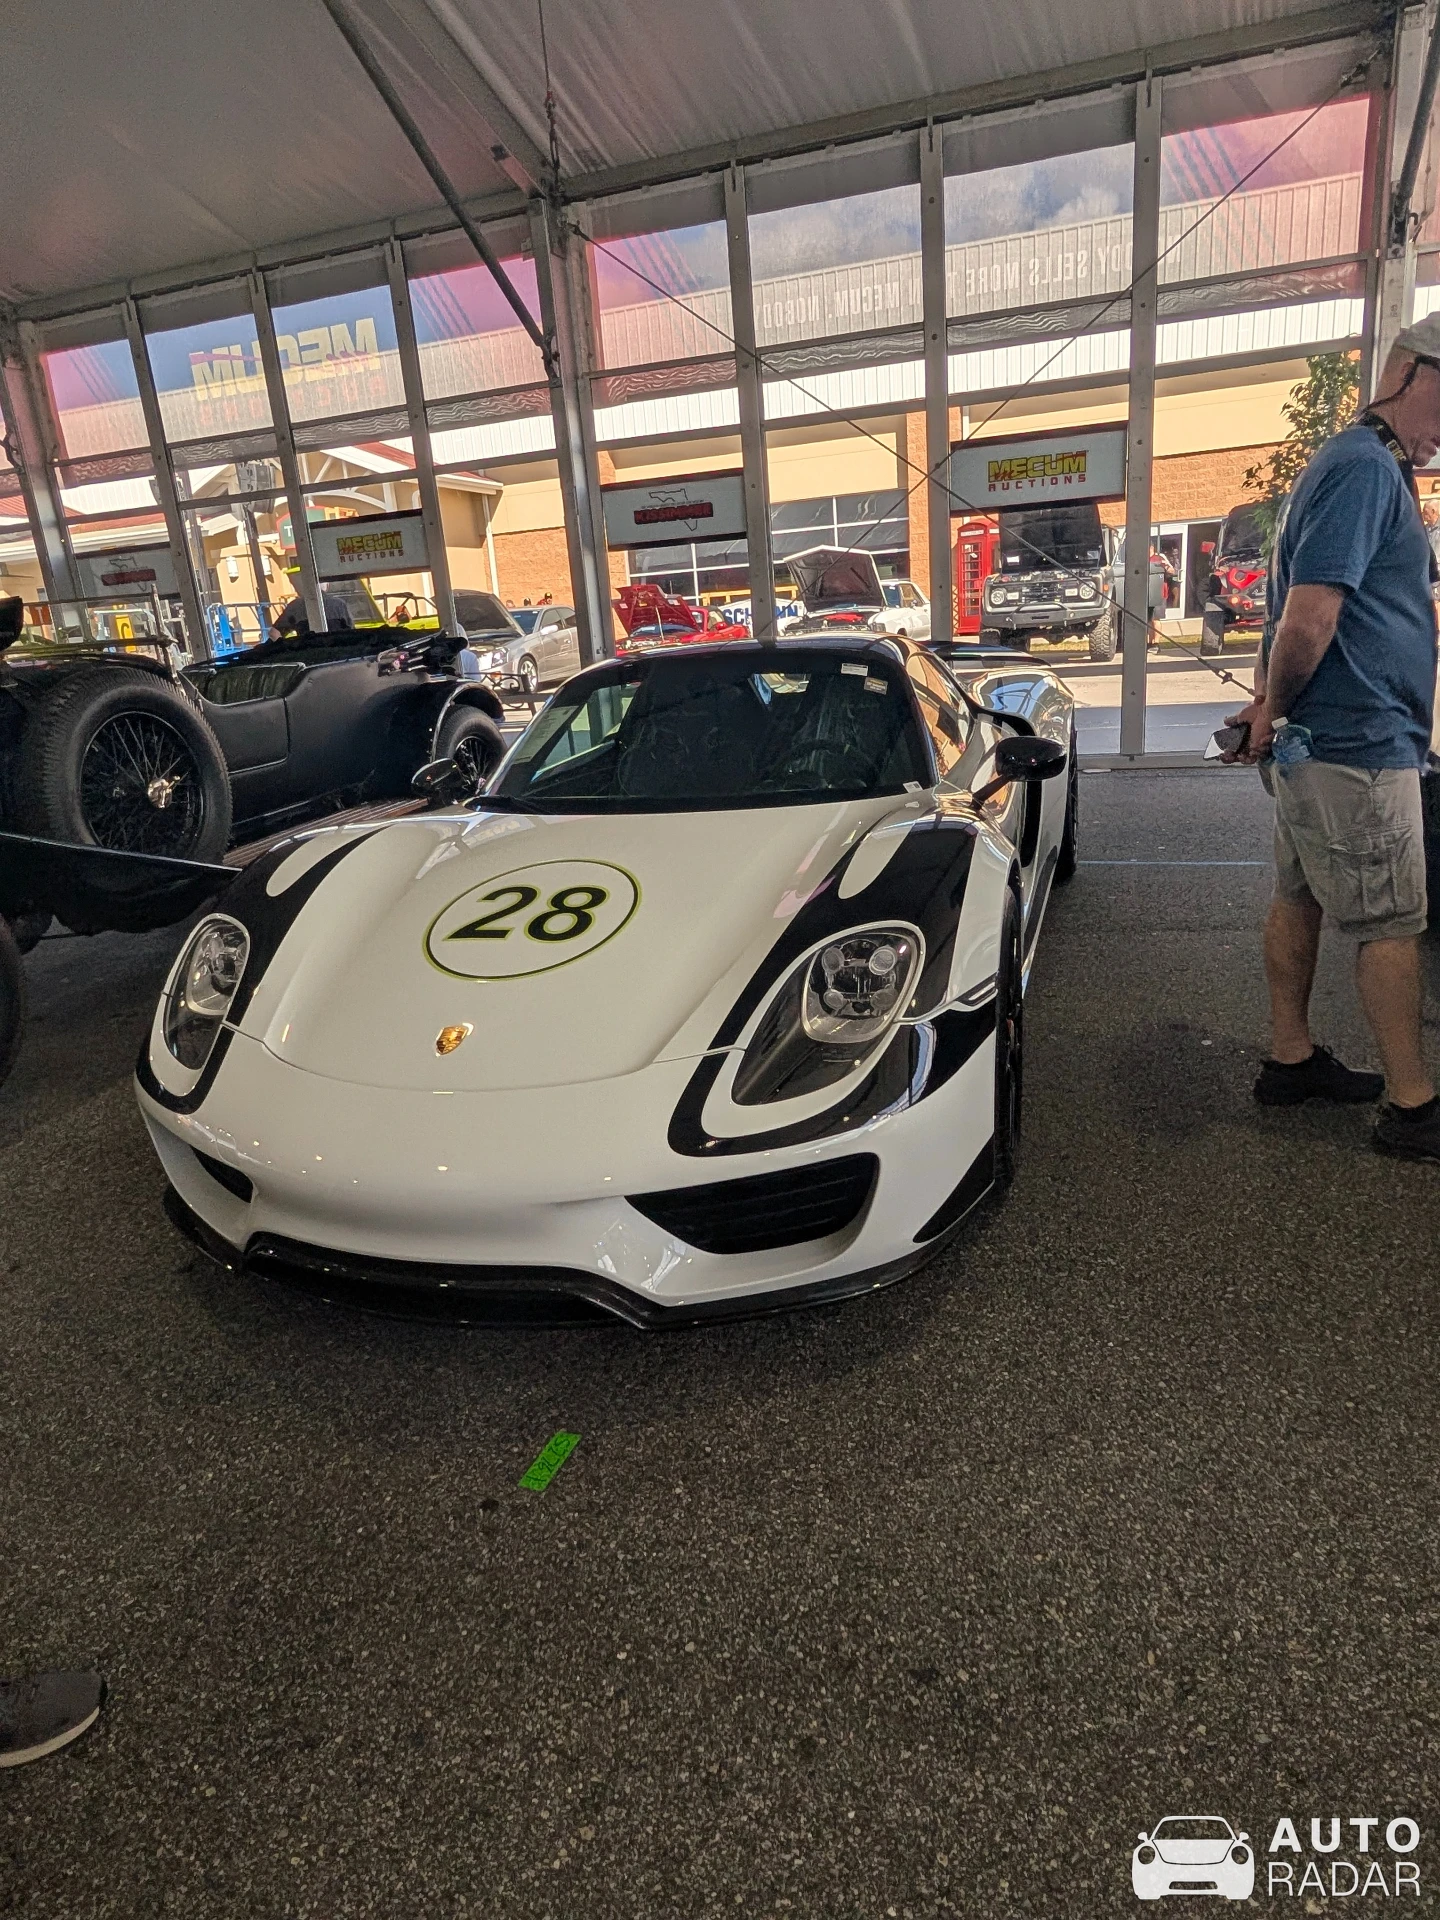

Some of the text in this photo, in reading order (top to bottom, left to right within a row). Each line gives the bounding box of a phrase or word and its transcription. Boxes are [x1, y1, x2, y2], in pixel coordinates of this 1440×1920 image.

[988, 451, 1087, 483] MECUM
[988, 474, 1086, 492] AUCTIONS
[336, 531, 403, 555] MECUM
[340, 549, 404, 563] AUCTIONS
[442, 884, 610, 943] 28
